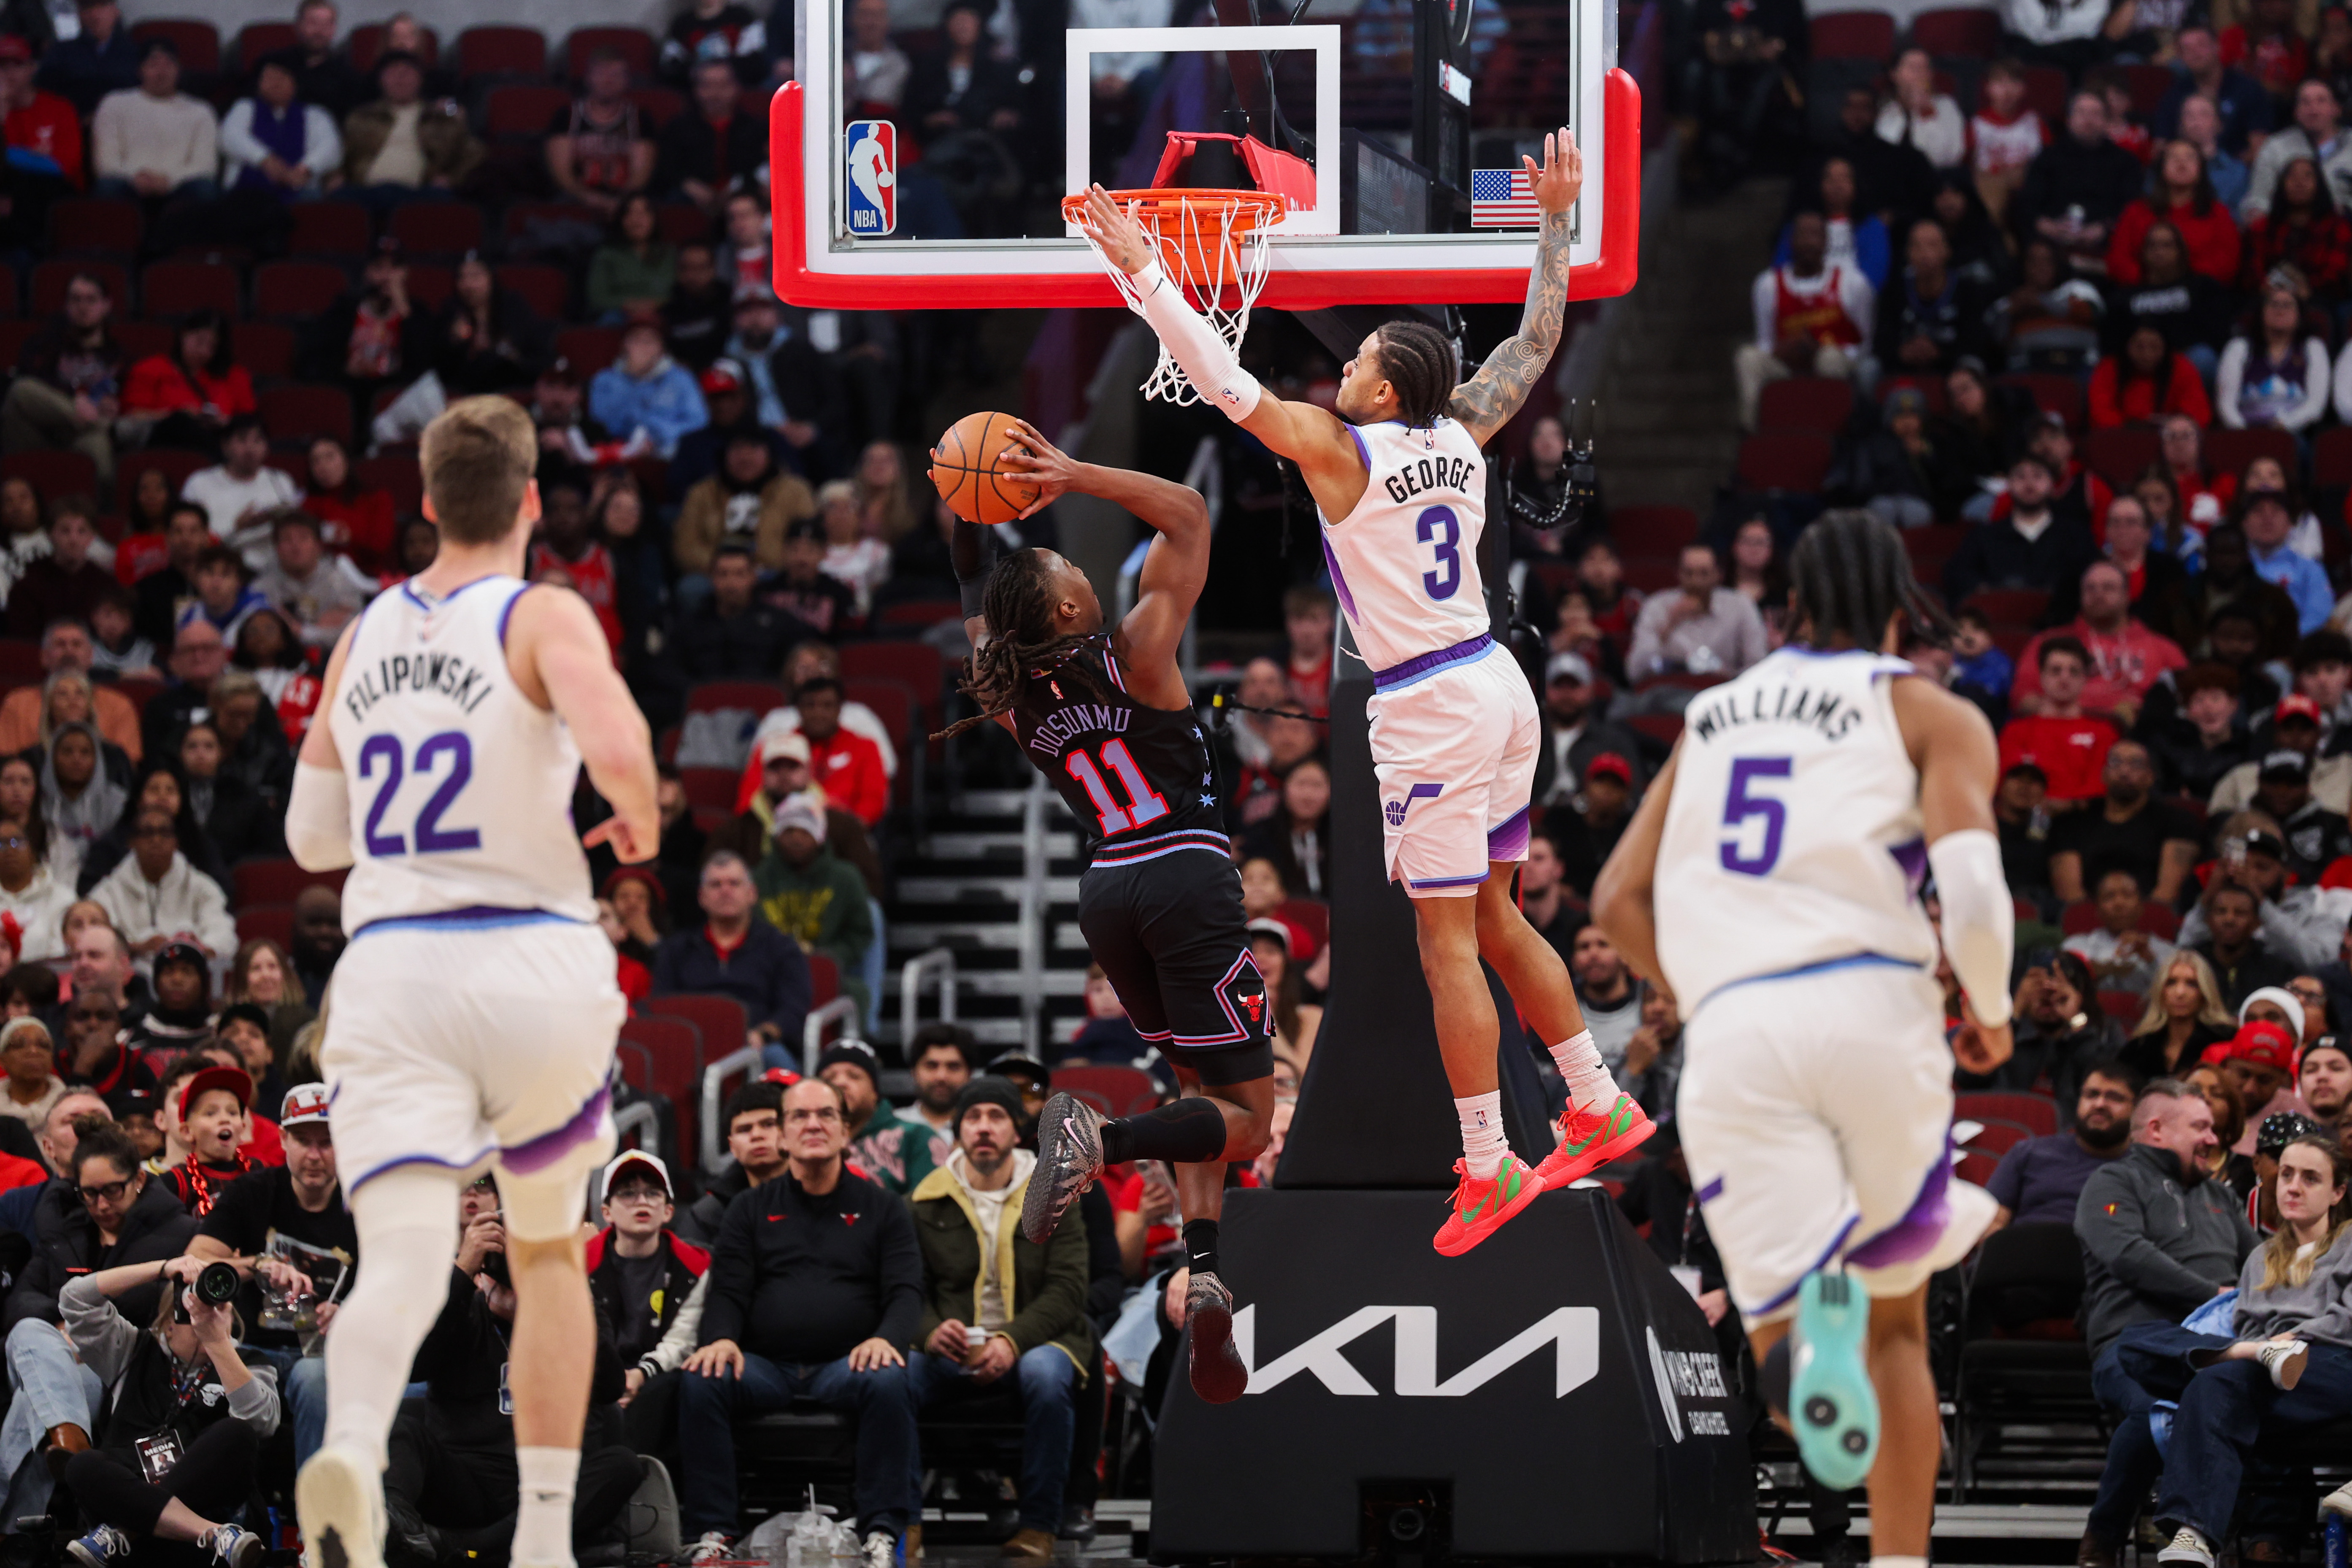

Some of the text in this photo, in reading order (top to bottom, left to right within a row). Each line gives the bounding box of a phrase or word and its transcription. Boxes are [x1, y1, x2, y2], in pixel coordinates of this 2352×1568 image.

[854, 209, 877, 227] NBA
[1385, 457, 1475, 503] GEORGE
[1416, 504, 1460, 602] 3
[345, 654, 492, 722] FILIPOWSKI
[1695, 687, 1862, 742] WILLIAMS
[1030, 704, 1132, 758] DOSUNMU
[359, 730, 481, 857] 22
[1065, 738, 1171, 838] 11
[1719, 757, 1792, 877] 5
[144, 1441, 176, 1457] MEDIA
